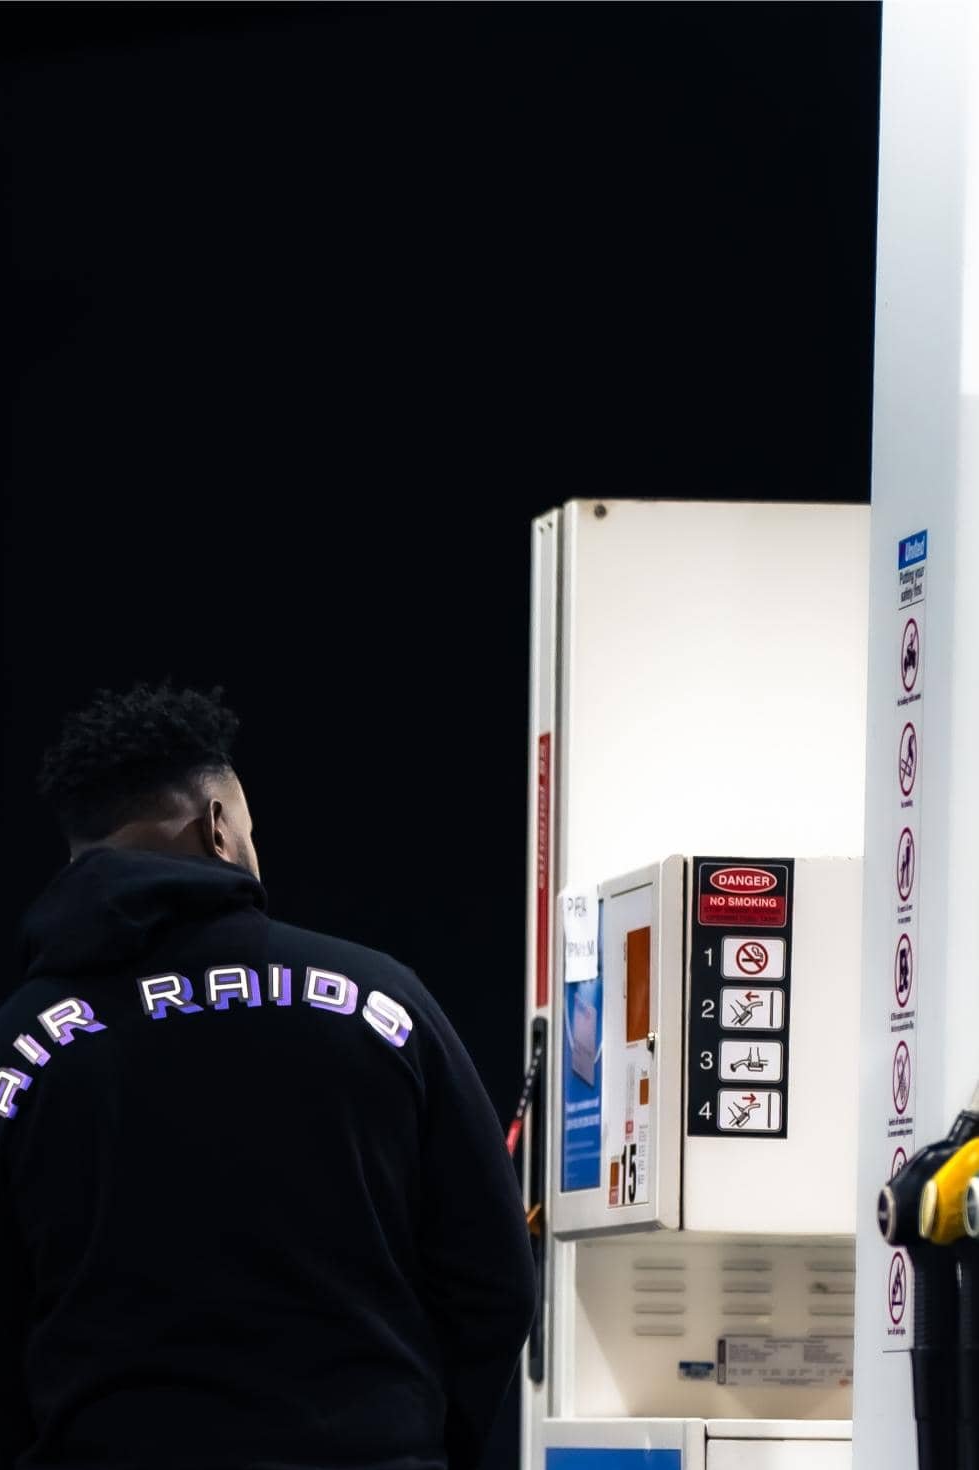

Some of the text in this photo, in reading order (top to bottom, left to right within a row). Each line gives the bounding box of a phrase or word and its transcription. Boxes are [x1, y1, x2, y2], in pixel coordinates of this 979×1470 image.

[718, 875, 770, 887] DANGER
[709, 895, 777, 908] NO SMOKING
[704, 948, 713, 967] 1
[137, 963, 414, 1048] RAIDS
[701, 1000, 715, 1019] 2
[699, 1051, 713, 1070] 3
[698, 1101, 713, 1121] 4
[621, 1143, 637, 1206] 15
